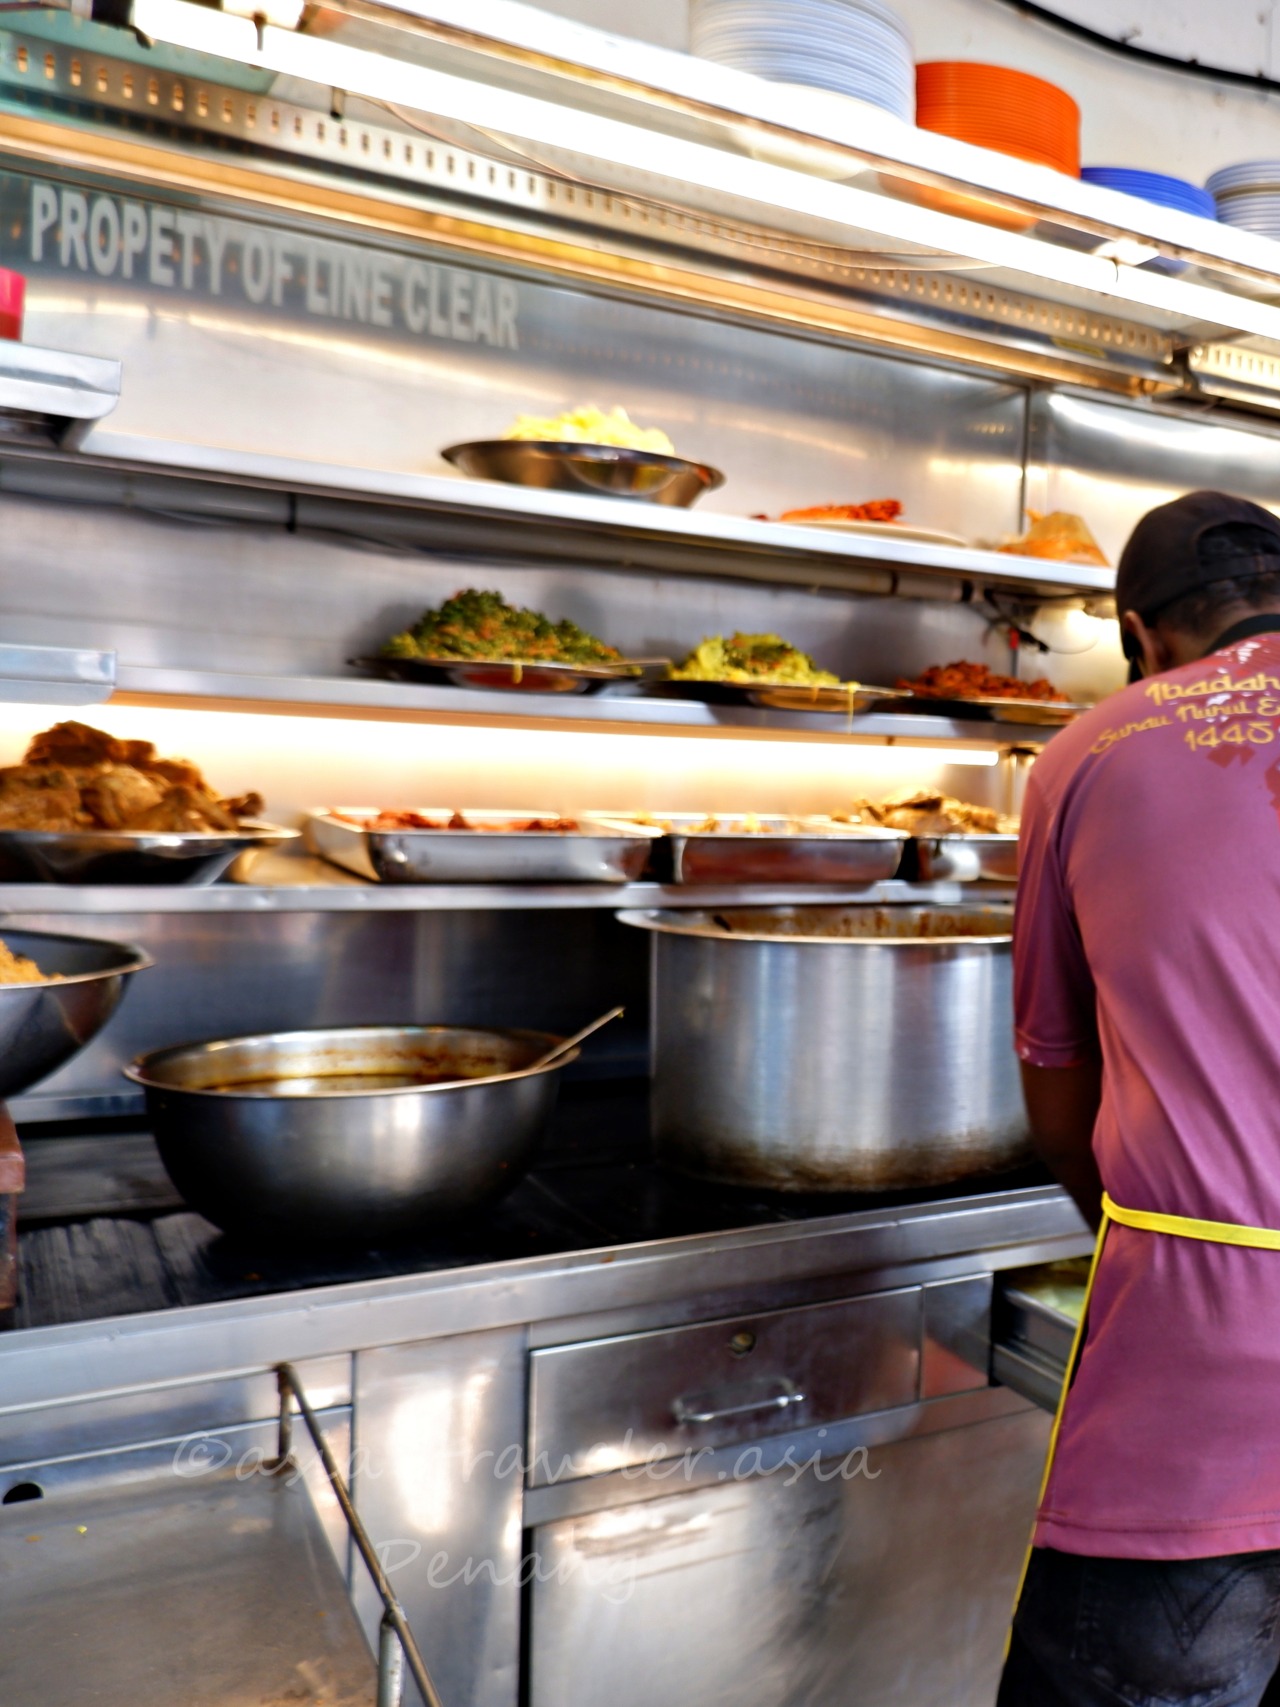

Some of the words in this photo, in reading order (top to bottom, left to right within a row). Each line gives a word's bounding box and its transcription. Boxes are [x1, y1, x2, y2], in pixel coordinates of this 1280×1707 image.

[32, 184, 230, 296] PROPETY
[242, 231, 293, 306] OF
[305, 248, 393, 328] LINE
[402, 263, 520, 351] CLEAR
[1091, 715, 1173, 754] Surau
[1176, 700, 1253, 723] Nurul
[1184, 721, 1274, 751] 1445
